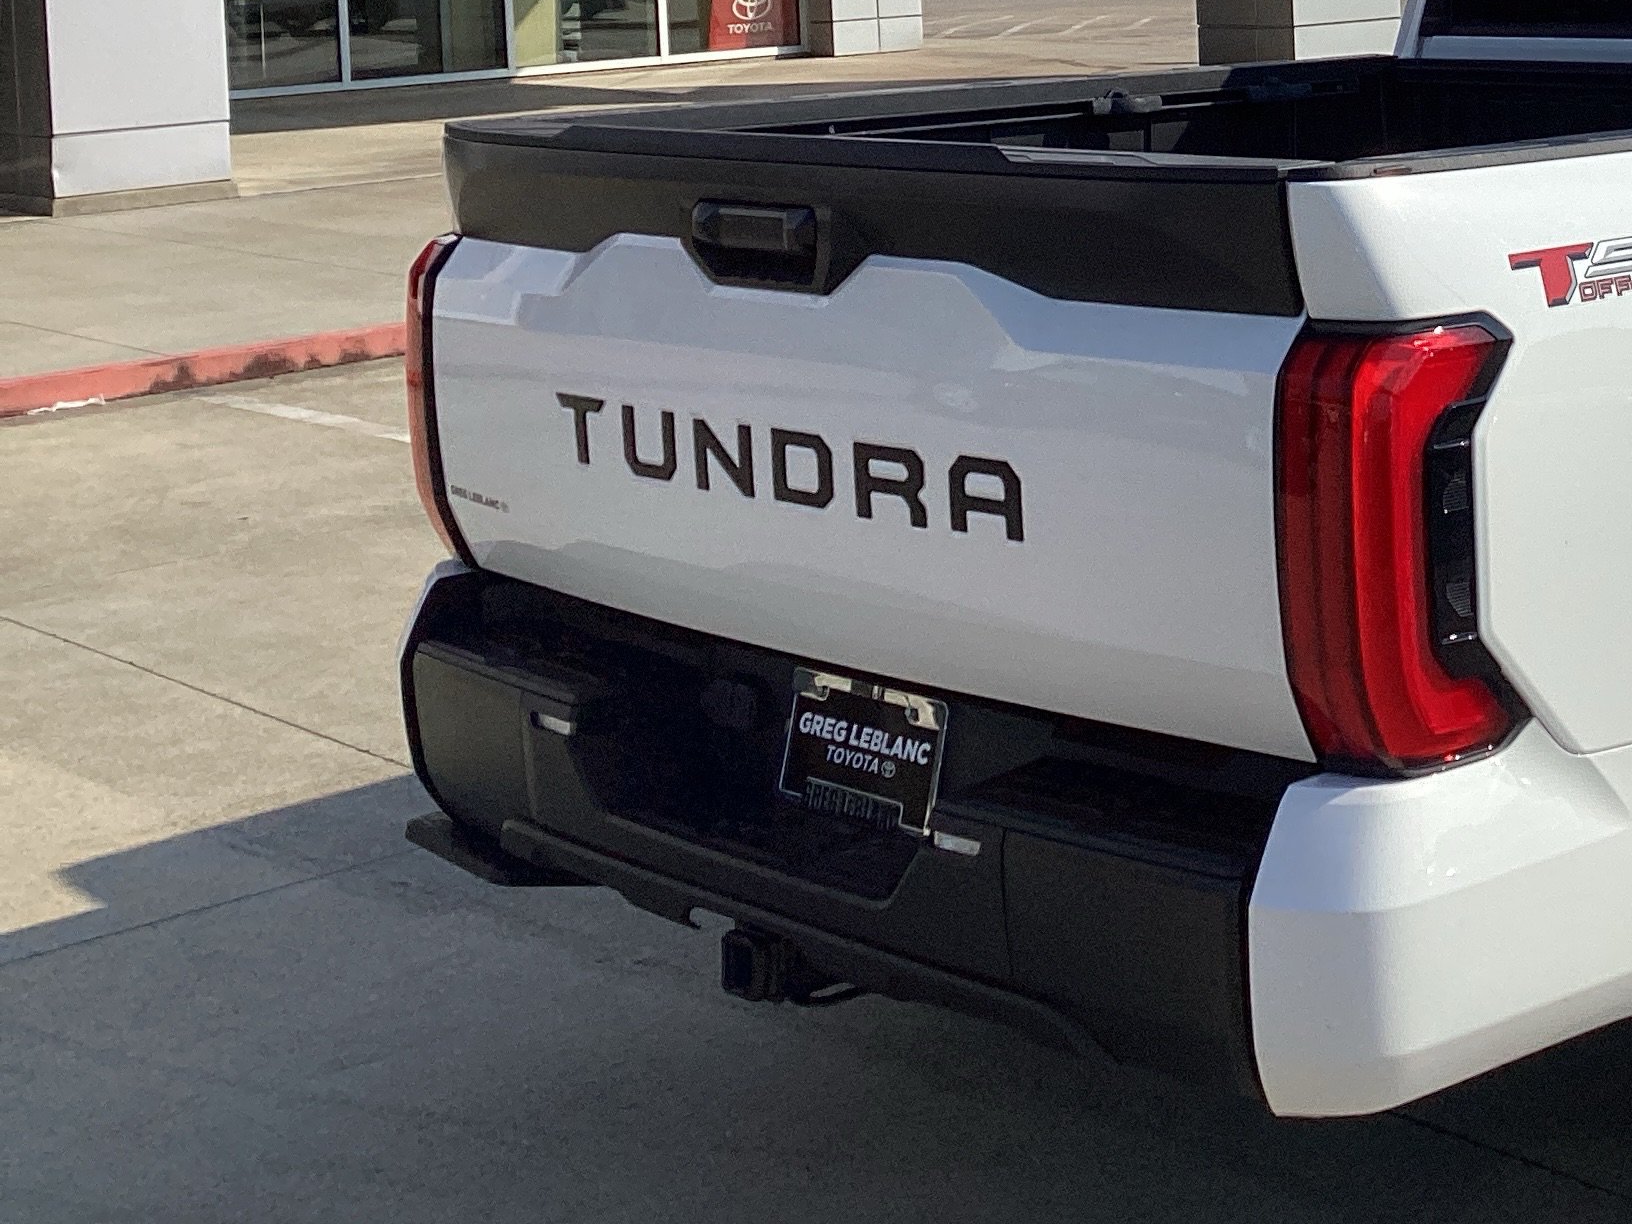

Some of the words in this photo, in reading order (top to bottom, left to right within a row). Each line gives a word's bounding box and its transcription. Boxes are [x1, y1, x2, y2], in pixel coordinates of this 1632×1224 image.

[727, 21, 774, 35] TOYOTA
[555, 391, 1025, 543] TUNDRA
[799, 711, 849, 743] GREG
[848, 724, 932, 765] LEBLANC
[826, 744, 879, 774] TOYOTA
